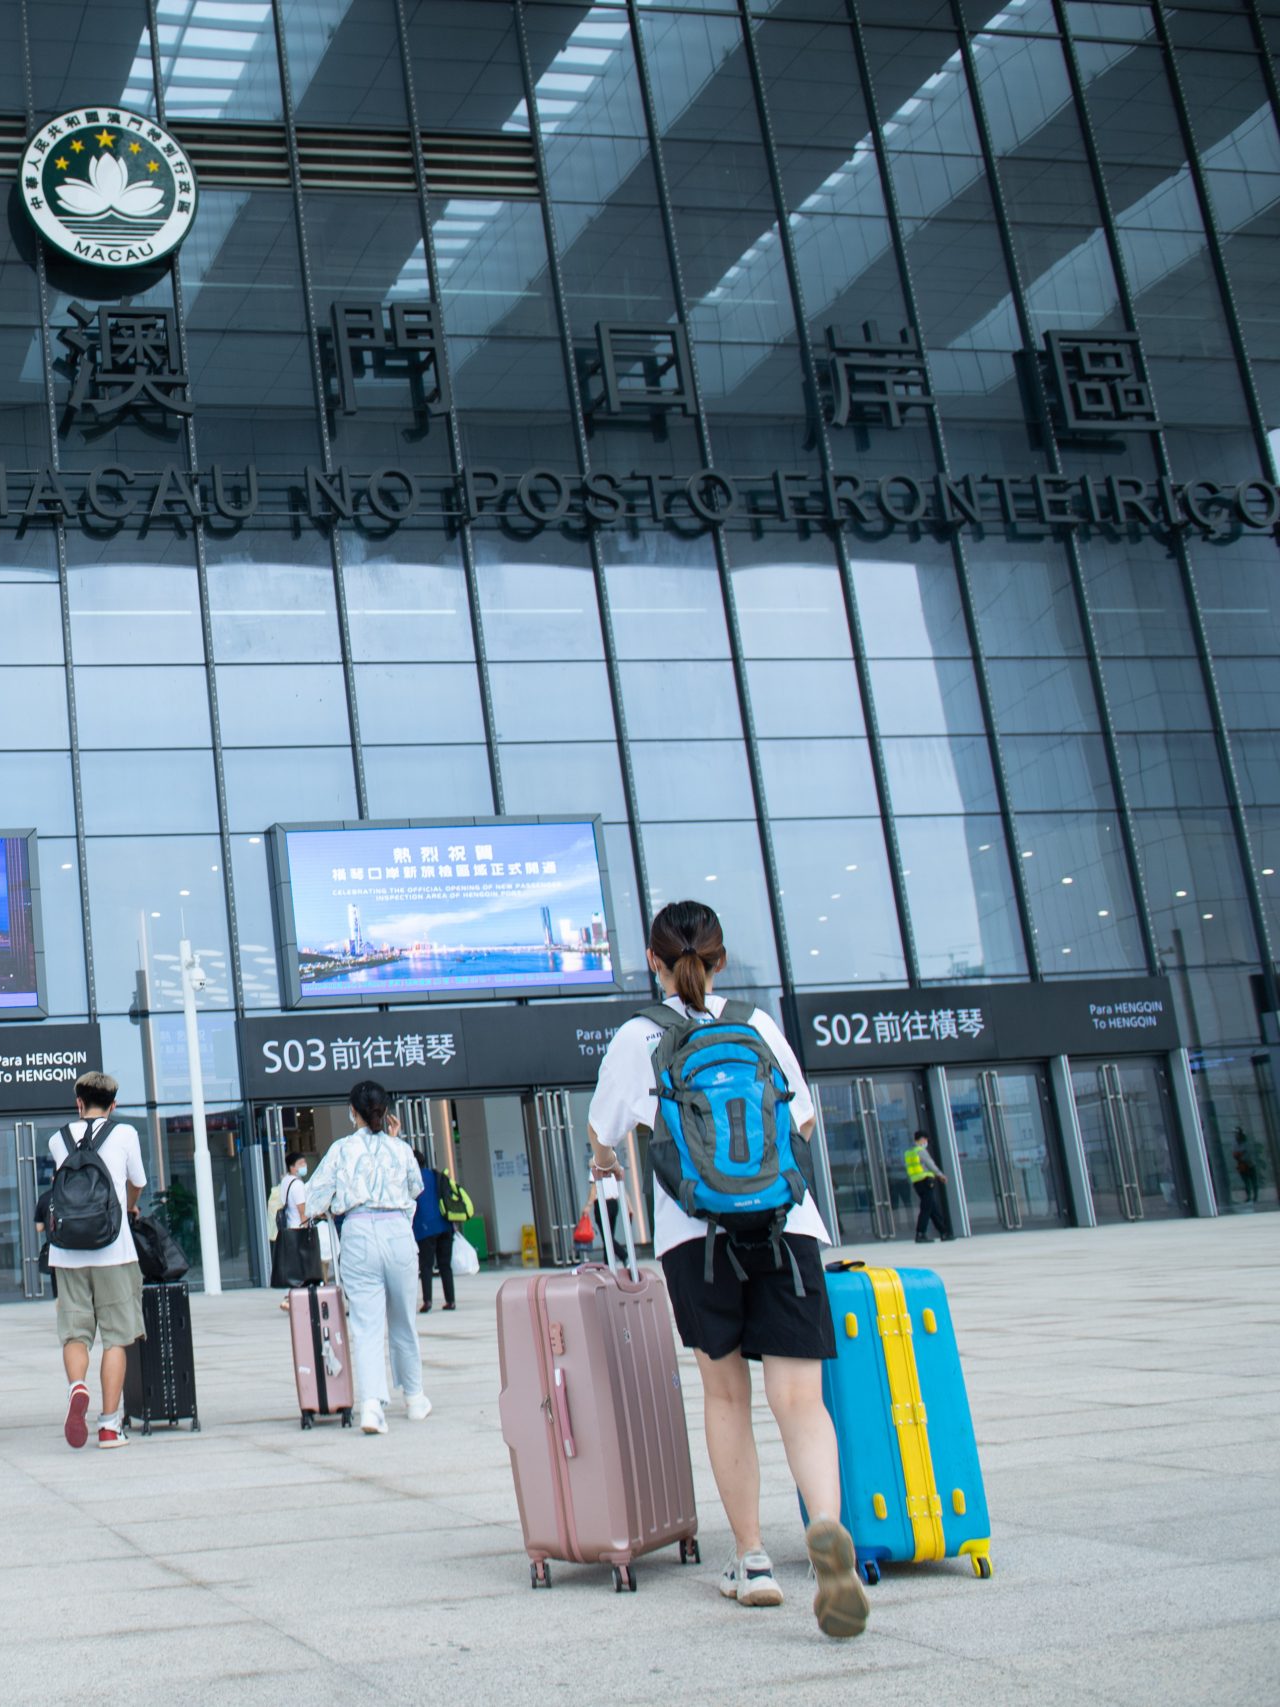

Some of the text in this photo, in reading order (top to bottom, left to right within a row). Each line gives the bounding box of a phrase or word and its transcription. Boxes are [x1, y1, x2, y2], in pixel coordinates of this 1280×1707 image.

[73, 240, 154, 262] MACAU
[306, 464, 421, 522] NO
[464, 465, 738, 523] POSTO
[332, 888, 387, 896] CELEBRATING
[375, 894, 424, 902] INSPECTION
[426, 892, 448, 900] AREA
[1089, 1000, 1163, 1015] Para HENGQIN
[812, 1008, 985, 1047] S02 前往橫琴
[1092, 1015, 1157, 1030] To HENGQIN
[575, 1028, 602, 1041] Para
[262, 1033, 457, 1074] S03 前往橫琴
[578, 1044, 594, 1056] To
[25, 1051, 87, 1066] HENGQIN
[16, 1067, 77, 1082] HENGQIN
